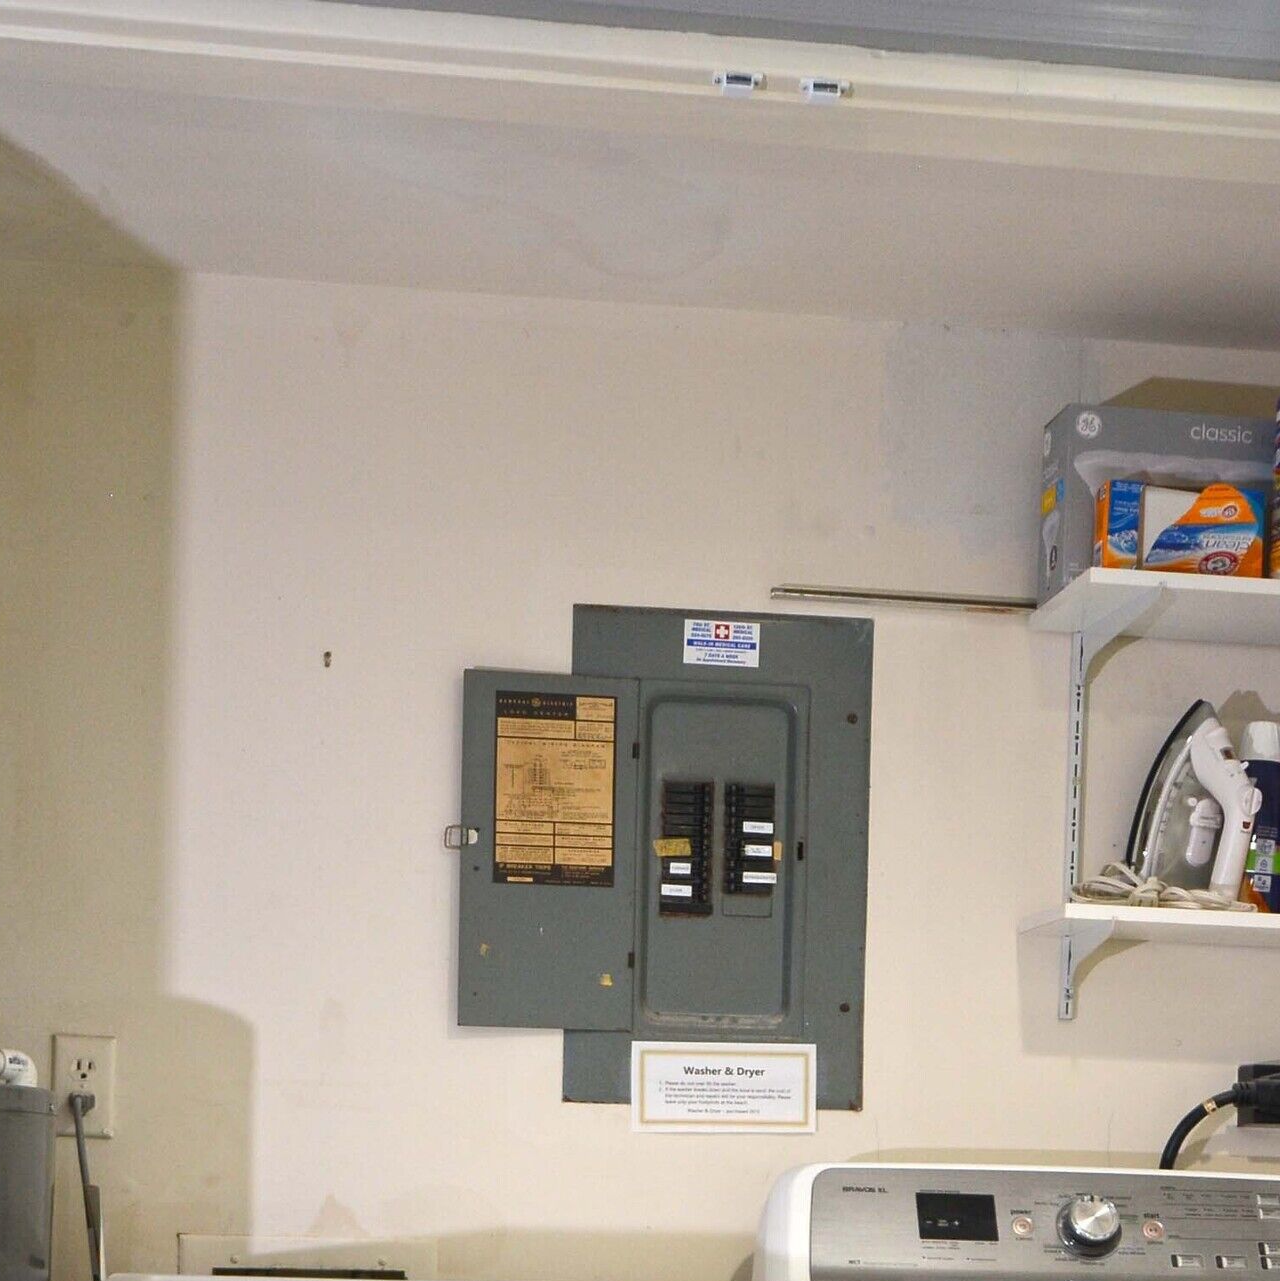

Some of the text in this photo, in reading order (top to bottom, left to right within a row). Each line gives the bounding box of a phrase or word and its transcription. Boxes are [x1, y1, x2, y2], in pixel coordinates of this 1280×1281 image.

[1190, 423, 1253, 444] classic
[683, 1066, 765, 1078] Washer & Dryer
